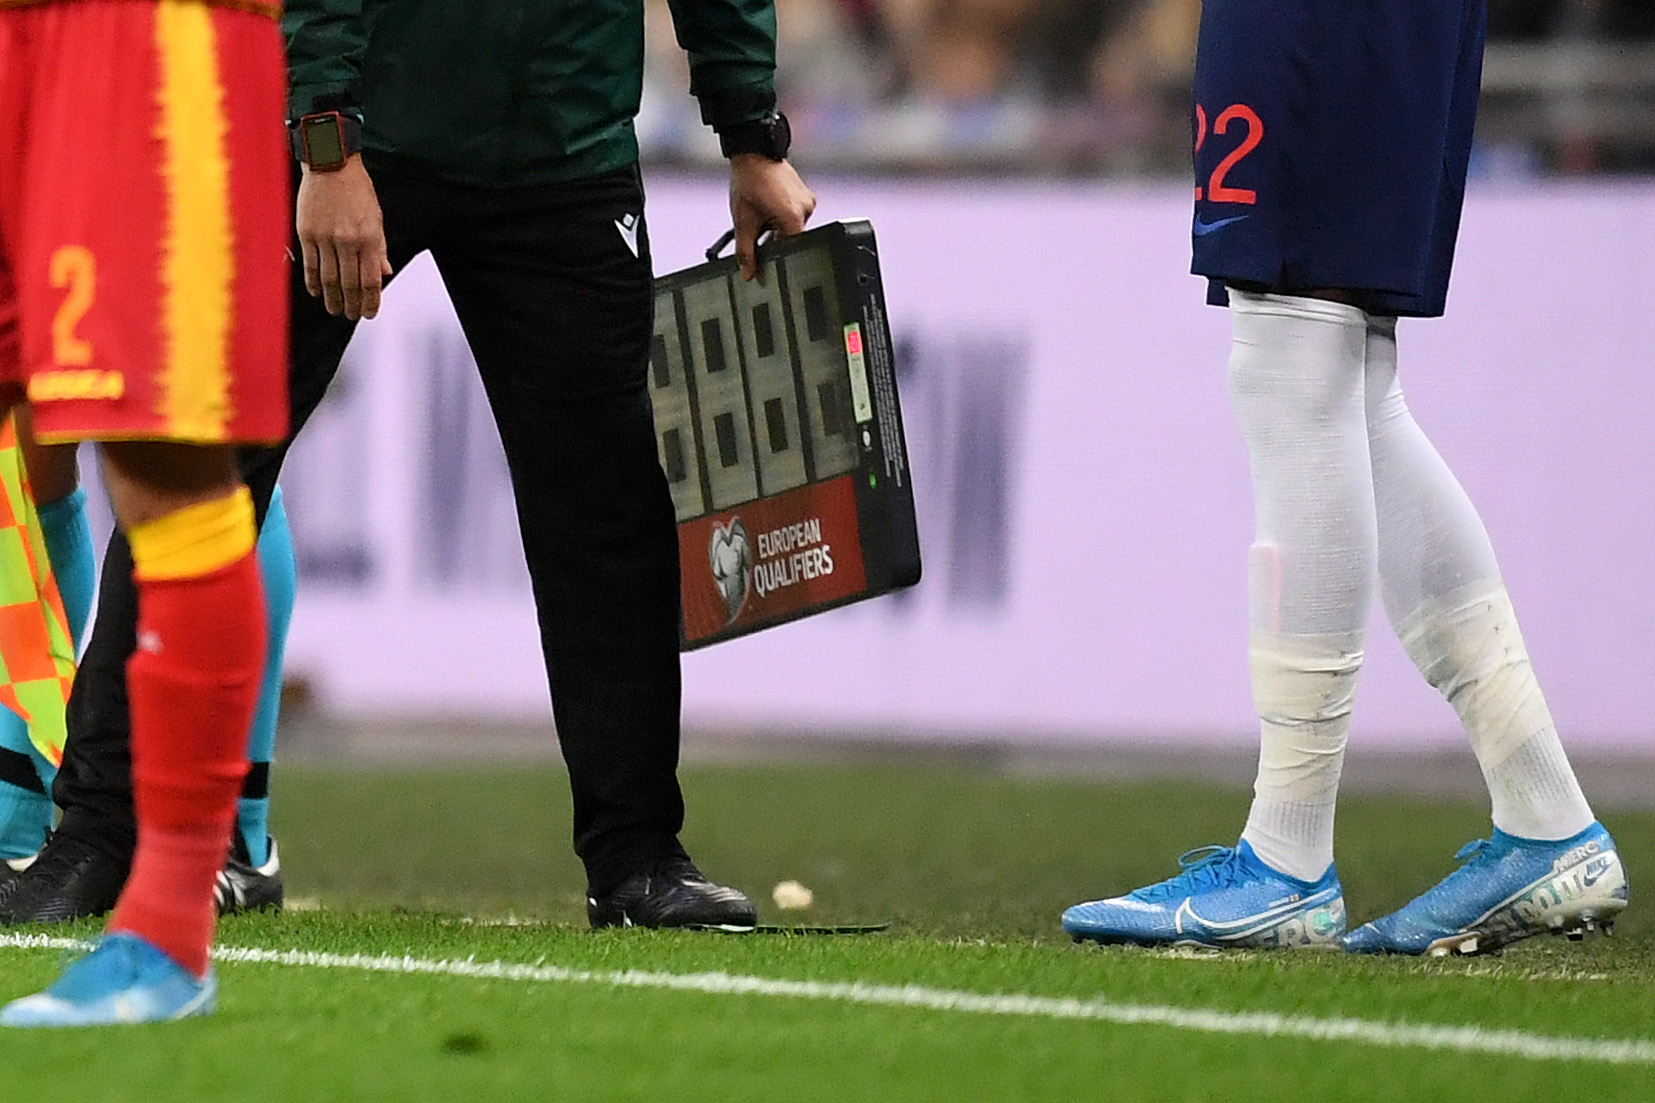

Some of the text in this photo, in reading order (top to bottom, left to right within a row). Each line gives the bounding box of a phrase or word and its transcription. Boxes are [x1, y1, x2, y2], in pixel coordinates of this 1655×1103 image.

[1195, 103, 1264, 205] 2
[49, 246, 96, 366] 2
[753, 544, 834, 598] QUALIFIERS
[757, 518, 822, 559] EUROPEAN
